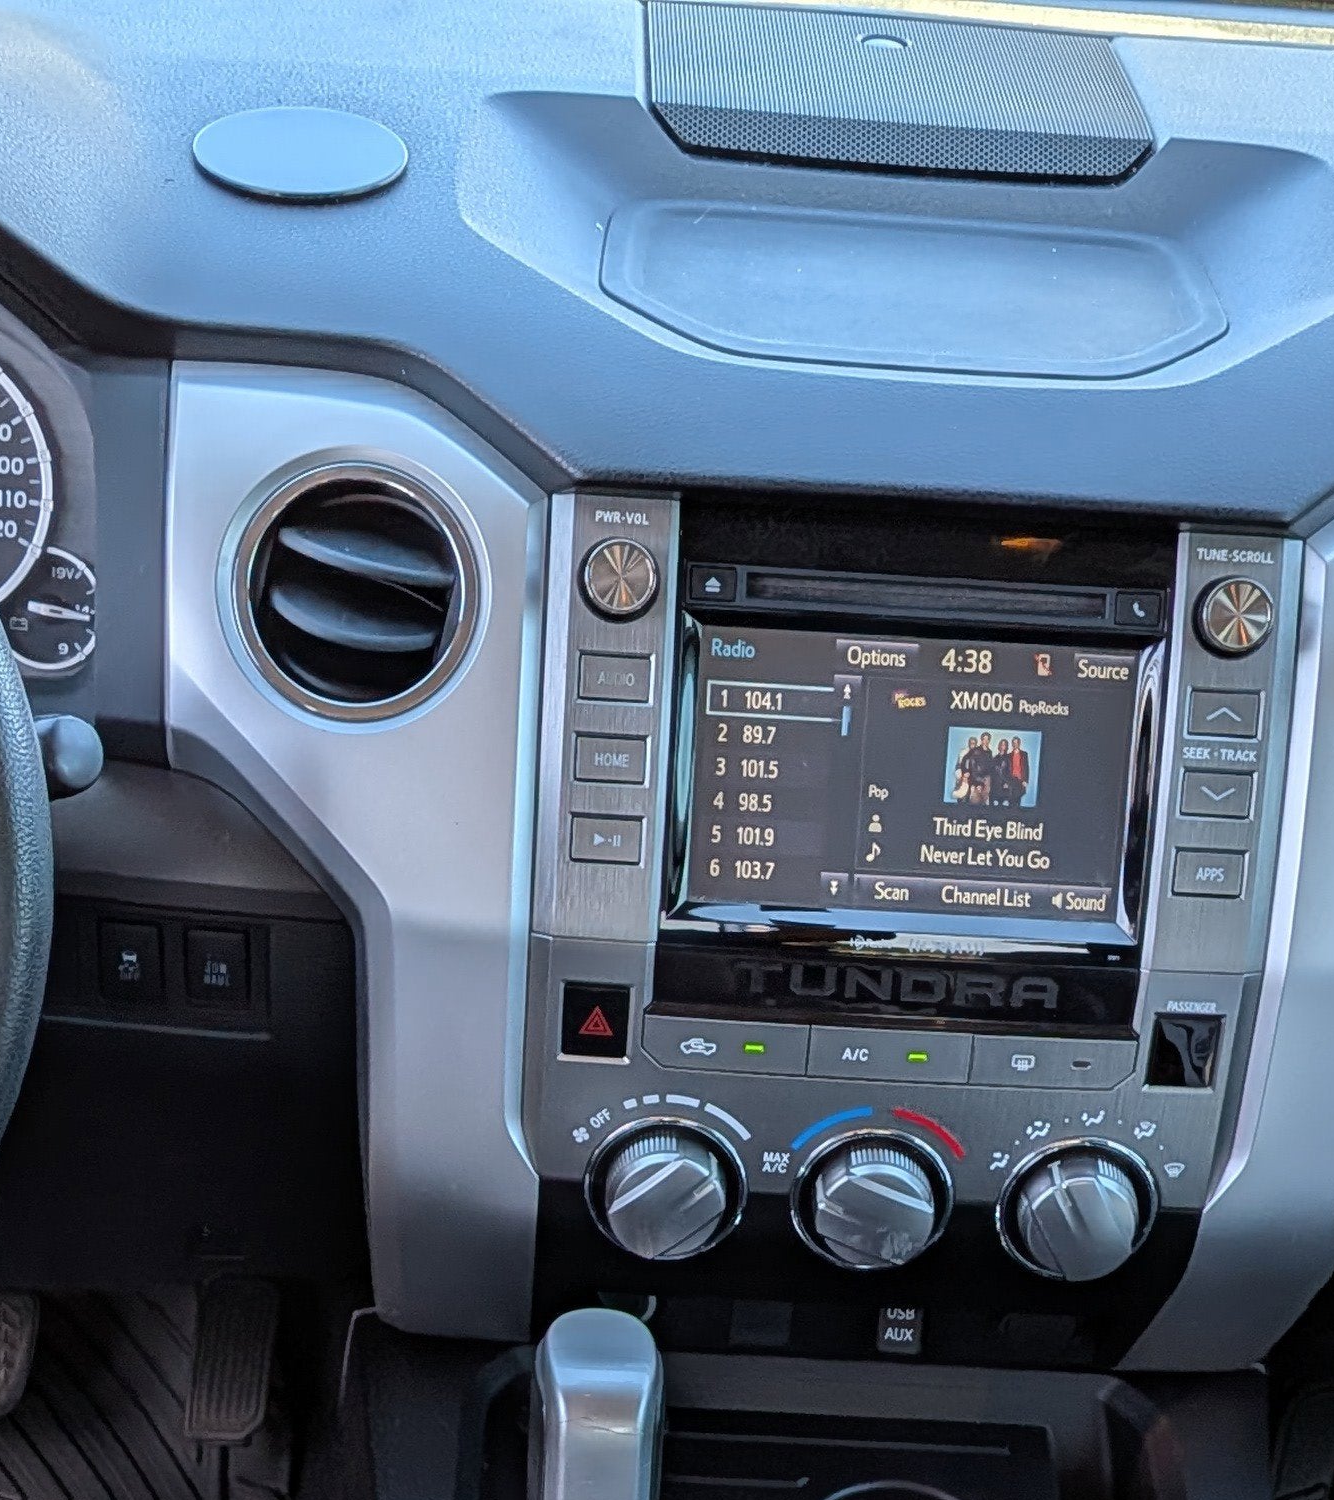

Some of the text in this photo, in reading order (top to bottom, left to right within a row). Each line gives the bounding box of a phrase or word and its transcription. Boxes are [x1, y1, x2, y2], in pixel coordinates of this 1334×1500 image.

[58, 643, 69, 655] 9
[711, 638, 756, 659] Radio
[847, 645, 906, 669] Options
[941, 648, 993, 675] 4:38
[1077, 659, 1129, 680] Source
[721, 689, 783, 711] 1 104.1
[950, 690, 1069, 717] XM006 PopRocks
[717, 723, 777, 745] 2 89.7
[594, 753, 629, 768] HOME
[1183, 747, 1257, 762] SEEK TRACK
[716, 757, 779, 779] 3 101.5
[713, 791, 772, 813] 4 98.5
[868, 784, 889, 801] Pop
[711, 825, 775, 847] 5 101.9
[933, 816, 1043, 842] Third Eye Blind
[920, 844, 1050, 870] Never Let You Go
[709, 858, 775, 880] 6 103.7
[1196, 867, 1225, 882] APPS
[874, 881, 909, 901] Scan
[941, 885, 1031, 908] Channel List
[1065, 891, 1107, 912] Sound
[734, 961, 1059, 1009] TUNDRA
[1167, 1001, 1216, 1013] PASSENGER
[841, 1047, 869, 1061] A/C
[590, 1108, 610, 1128] OFF
[762, 1151, 790, 1164] MAX
[762, 1162, 787, 1174] A/C
[887, 1308, 915, 1320] USB
[884, 1327, 914, 1341] AUX
